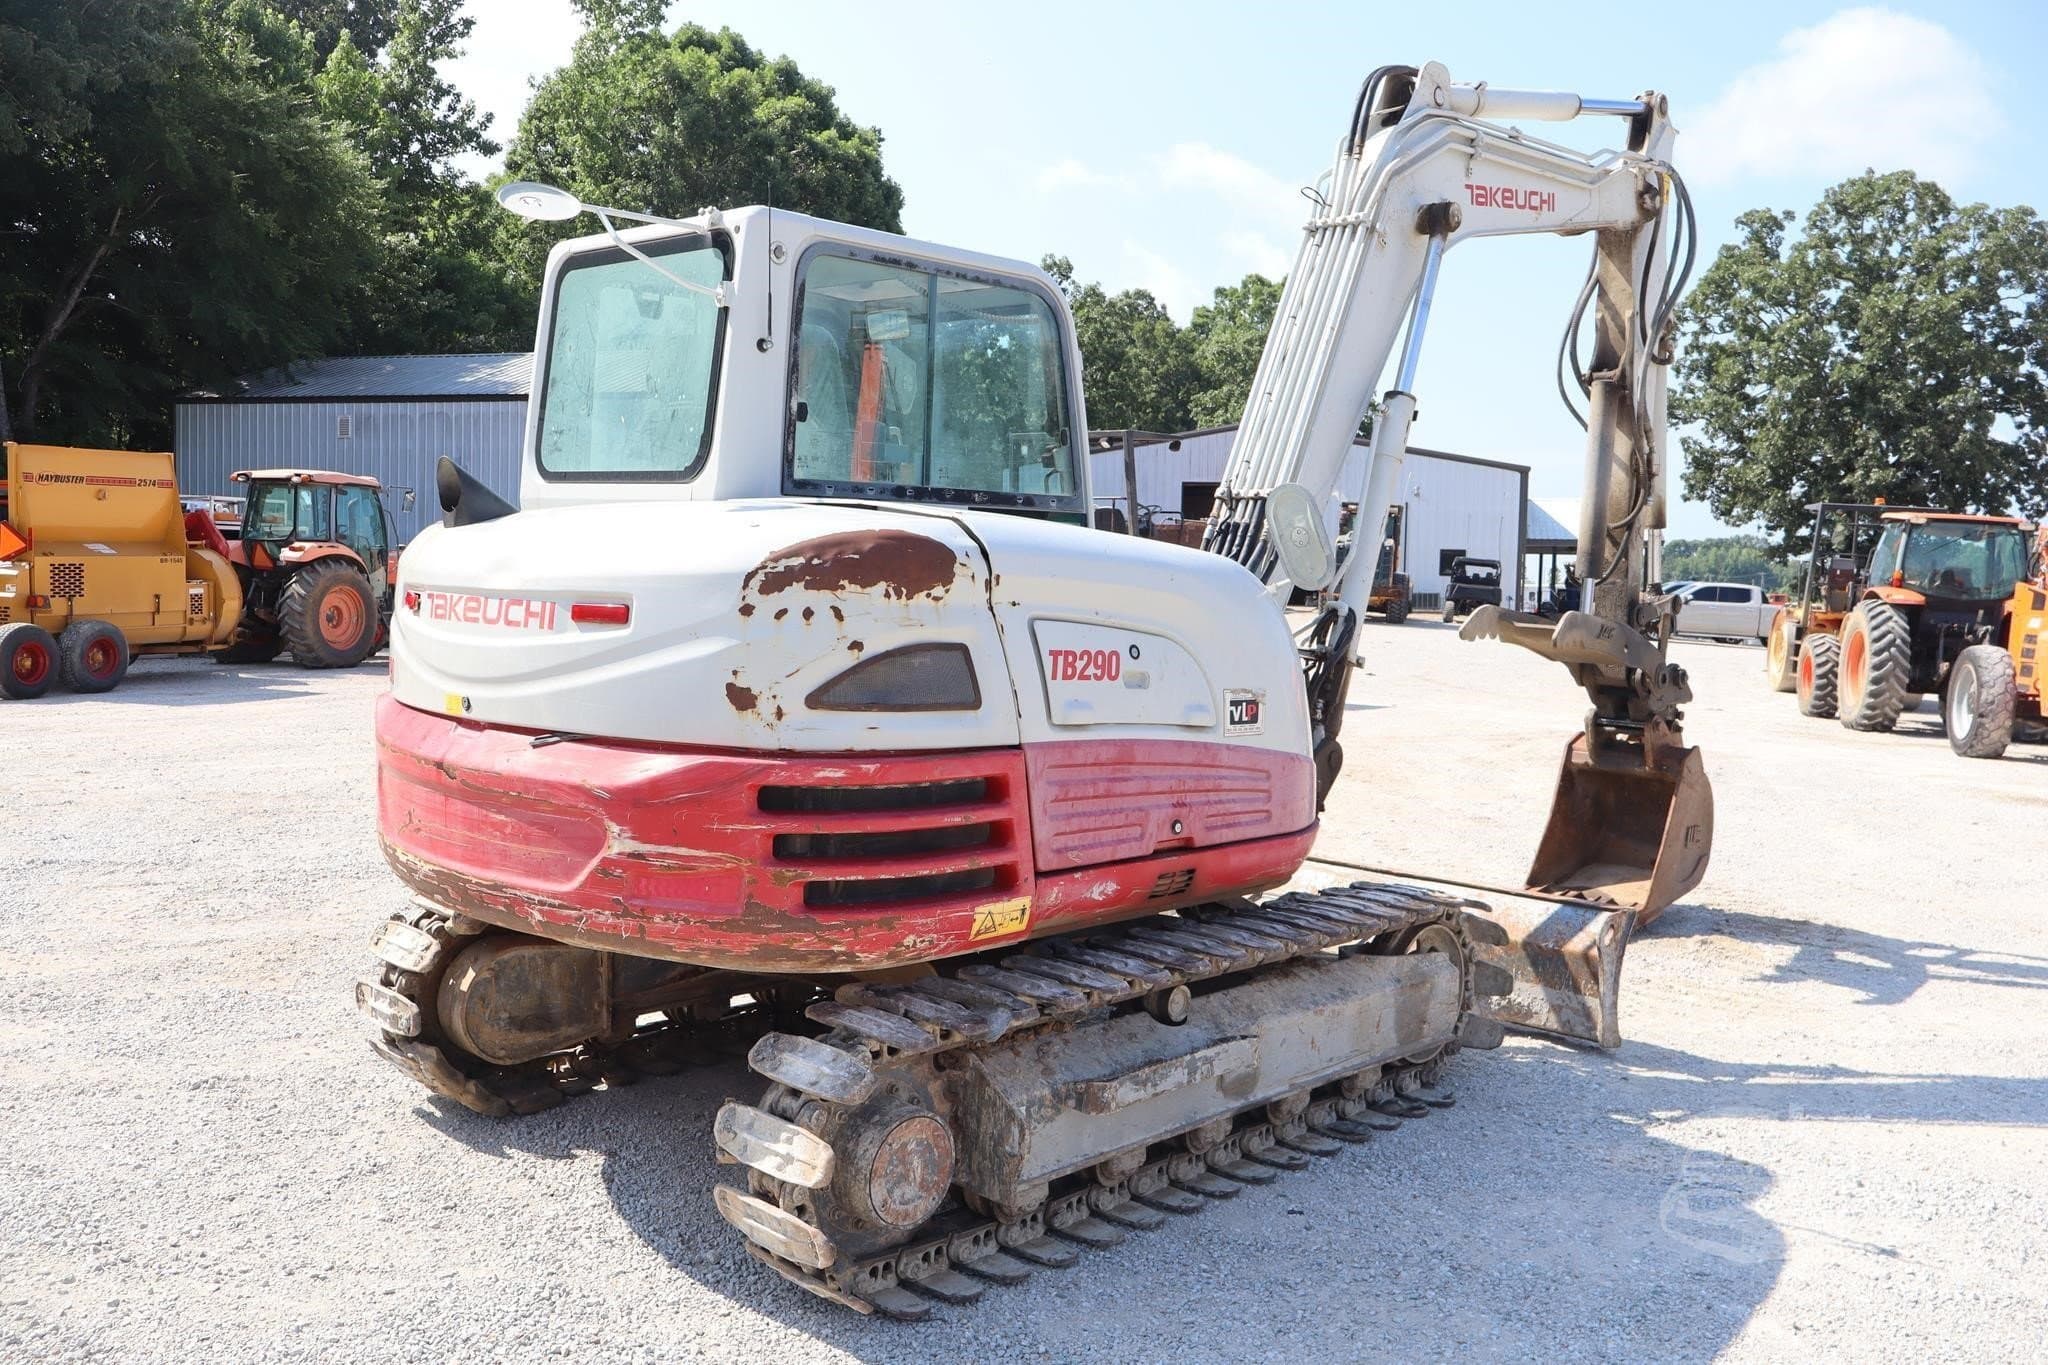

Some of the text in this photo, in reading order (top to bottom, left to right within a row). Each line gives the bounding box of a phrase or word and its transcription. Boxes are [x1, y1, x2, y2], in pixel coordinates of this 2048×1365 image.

[1465, 184, 1555, 212] TAKEUCHI
[38, 473, 157, 487] HAYBUSTER 2574
[427, 592, 556, 631] TAKEUCHI
[1049, 650, 1120, 681] TB290
